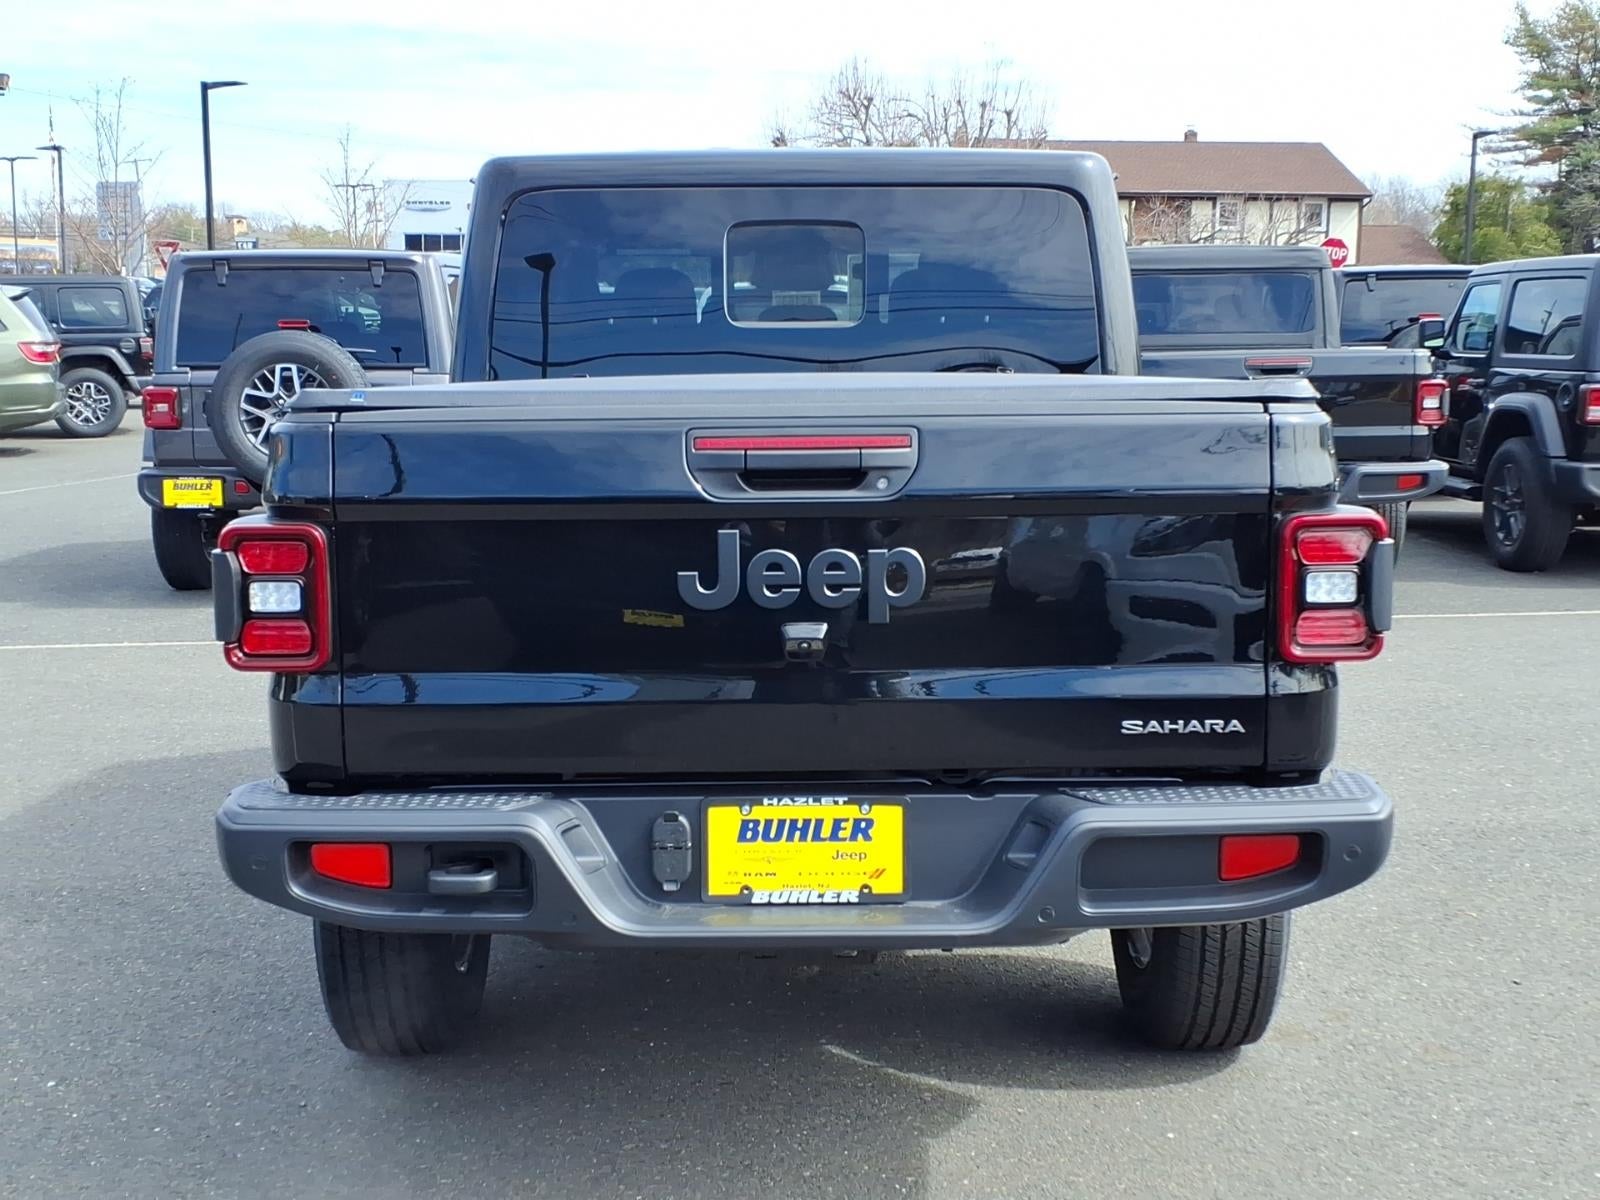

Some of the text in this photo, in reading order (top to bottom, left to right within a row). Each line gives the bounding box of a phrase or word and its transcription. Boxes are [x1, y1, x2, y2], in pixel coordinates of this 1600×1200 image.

[1323, 246, 1348, 260] TOP
[172, 482, 213, 490] BUHLER
[677, 529, 926, 624] Jeep
[1120, 719, 1246, 734] SAHARA
[762, 797, 849, 807] HAZLET
[736, 817, 875, 843] BUHLER
[831, 850, 868, 862] Jeep
[750, 889, 860, 904] BUHLER
